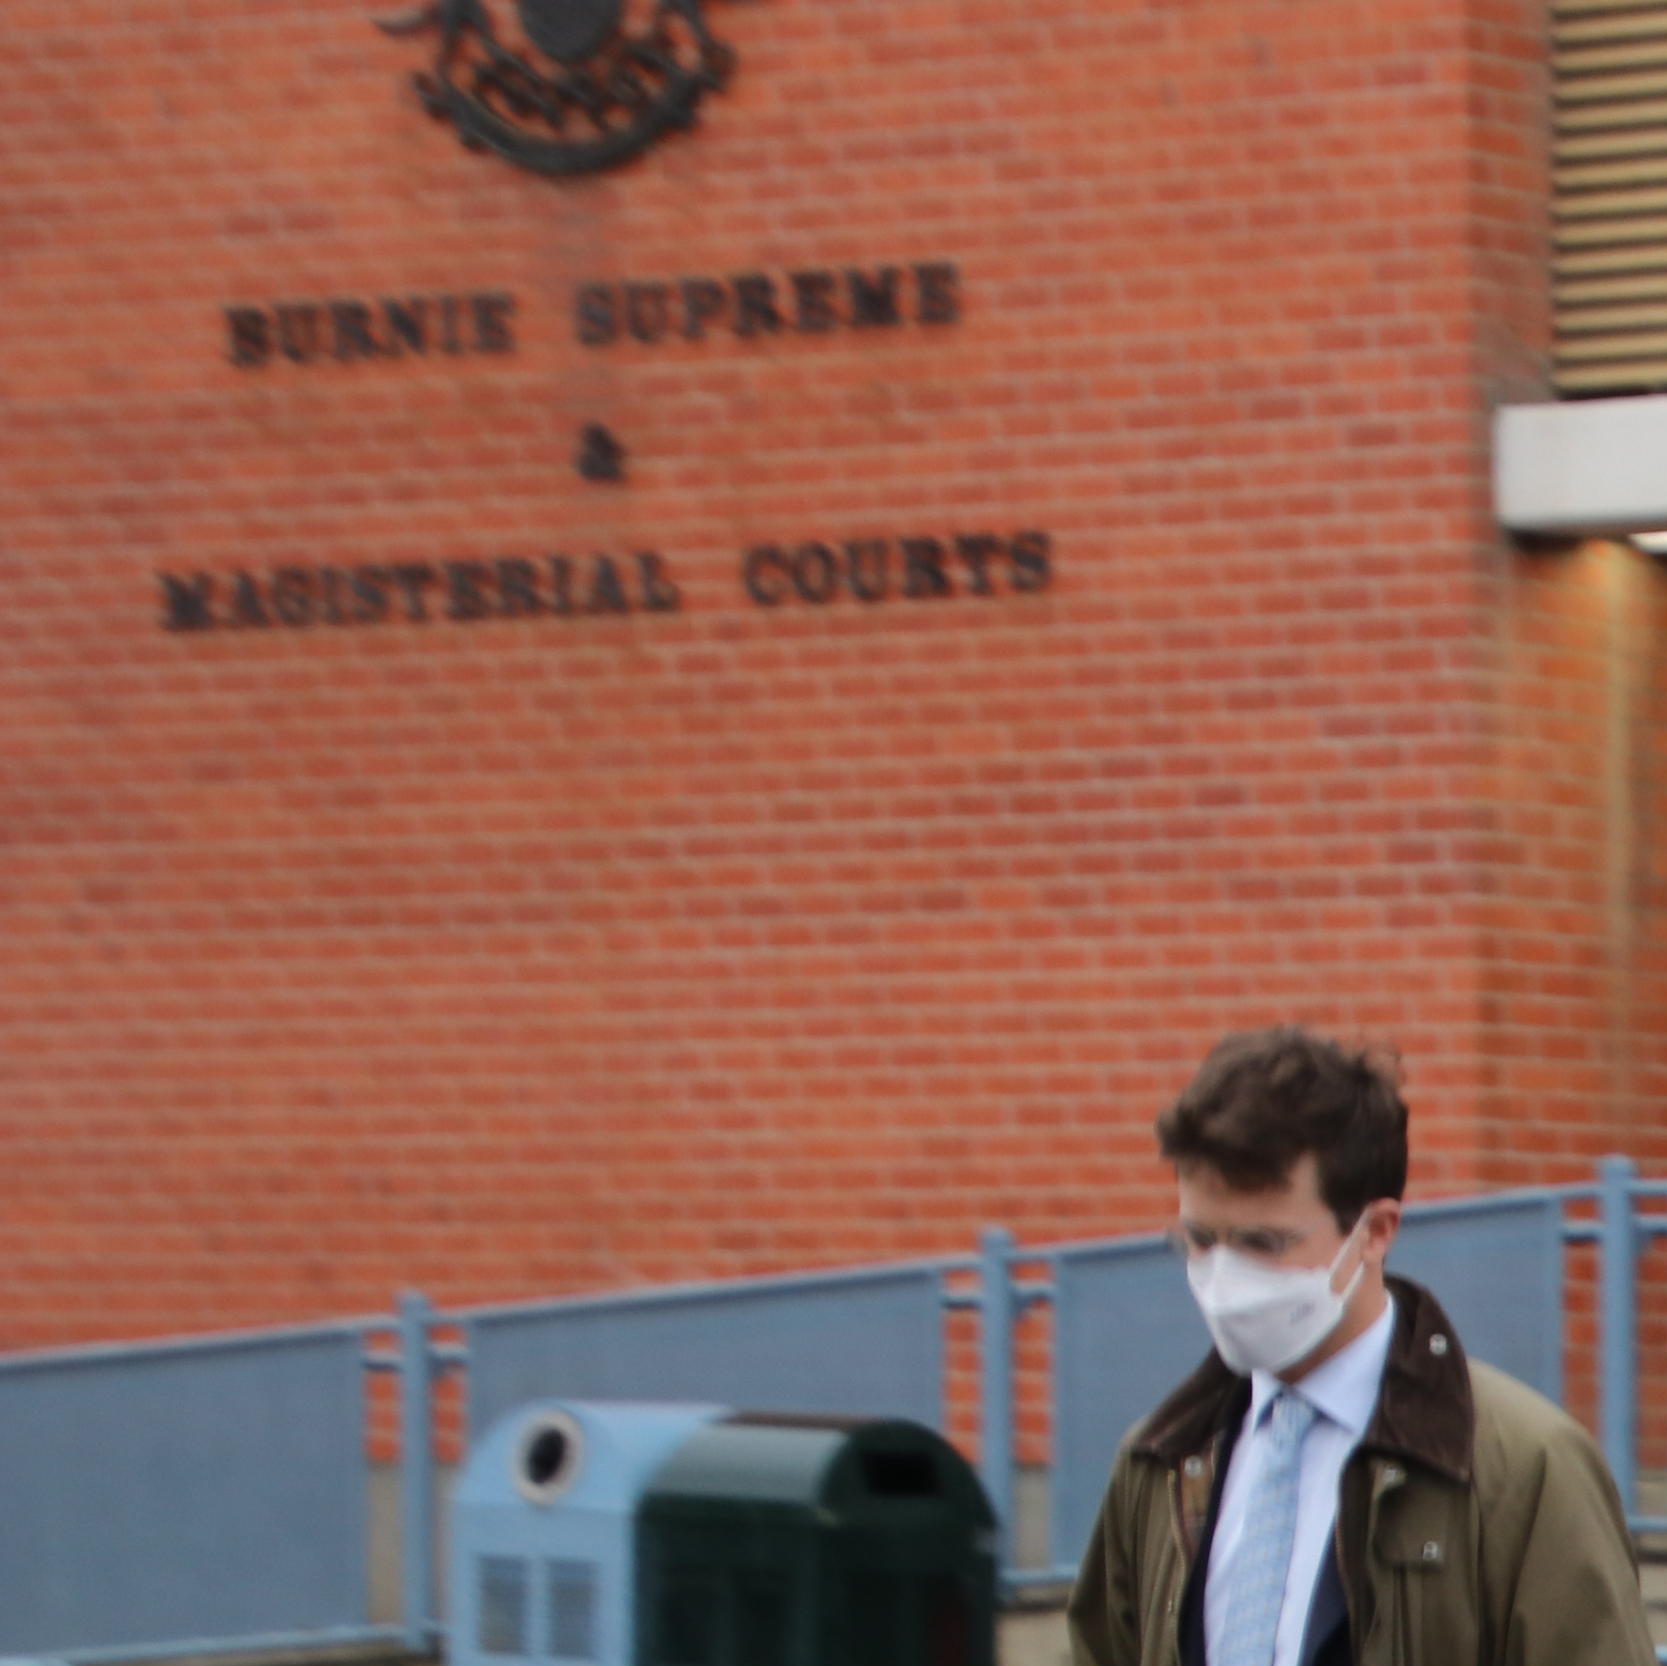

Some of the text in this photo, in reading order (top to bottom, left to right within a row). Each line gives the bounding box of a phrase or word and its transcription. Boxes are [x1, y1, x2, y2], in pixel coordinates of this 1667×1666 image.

[225, 263, 961, 367] BURNIE SUPREME
[160, 532, 1053, 632] MAGISTERIAL COURTS
